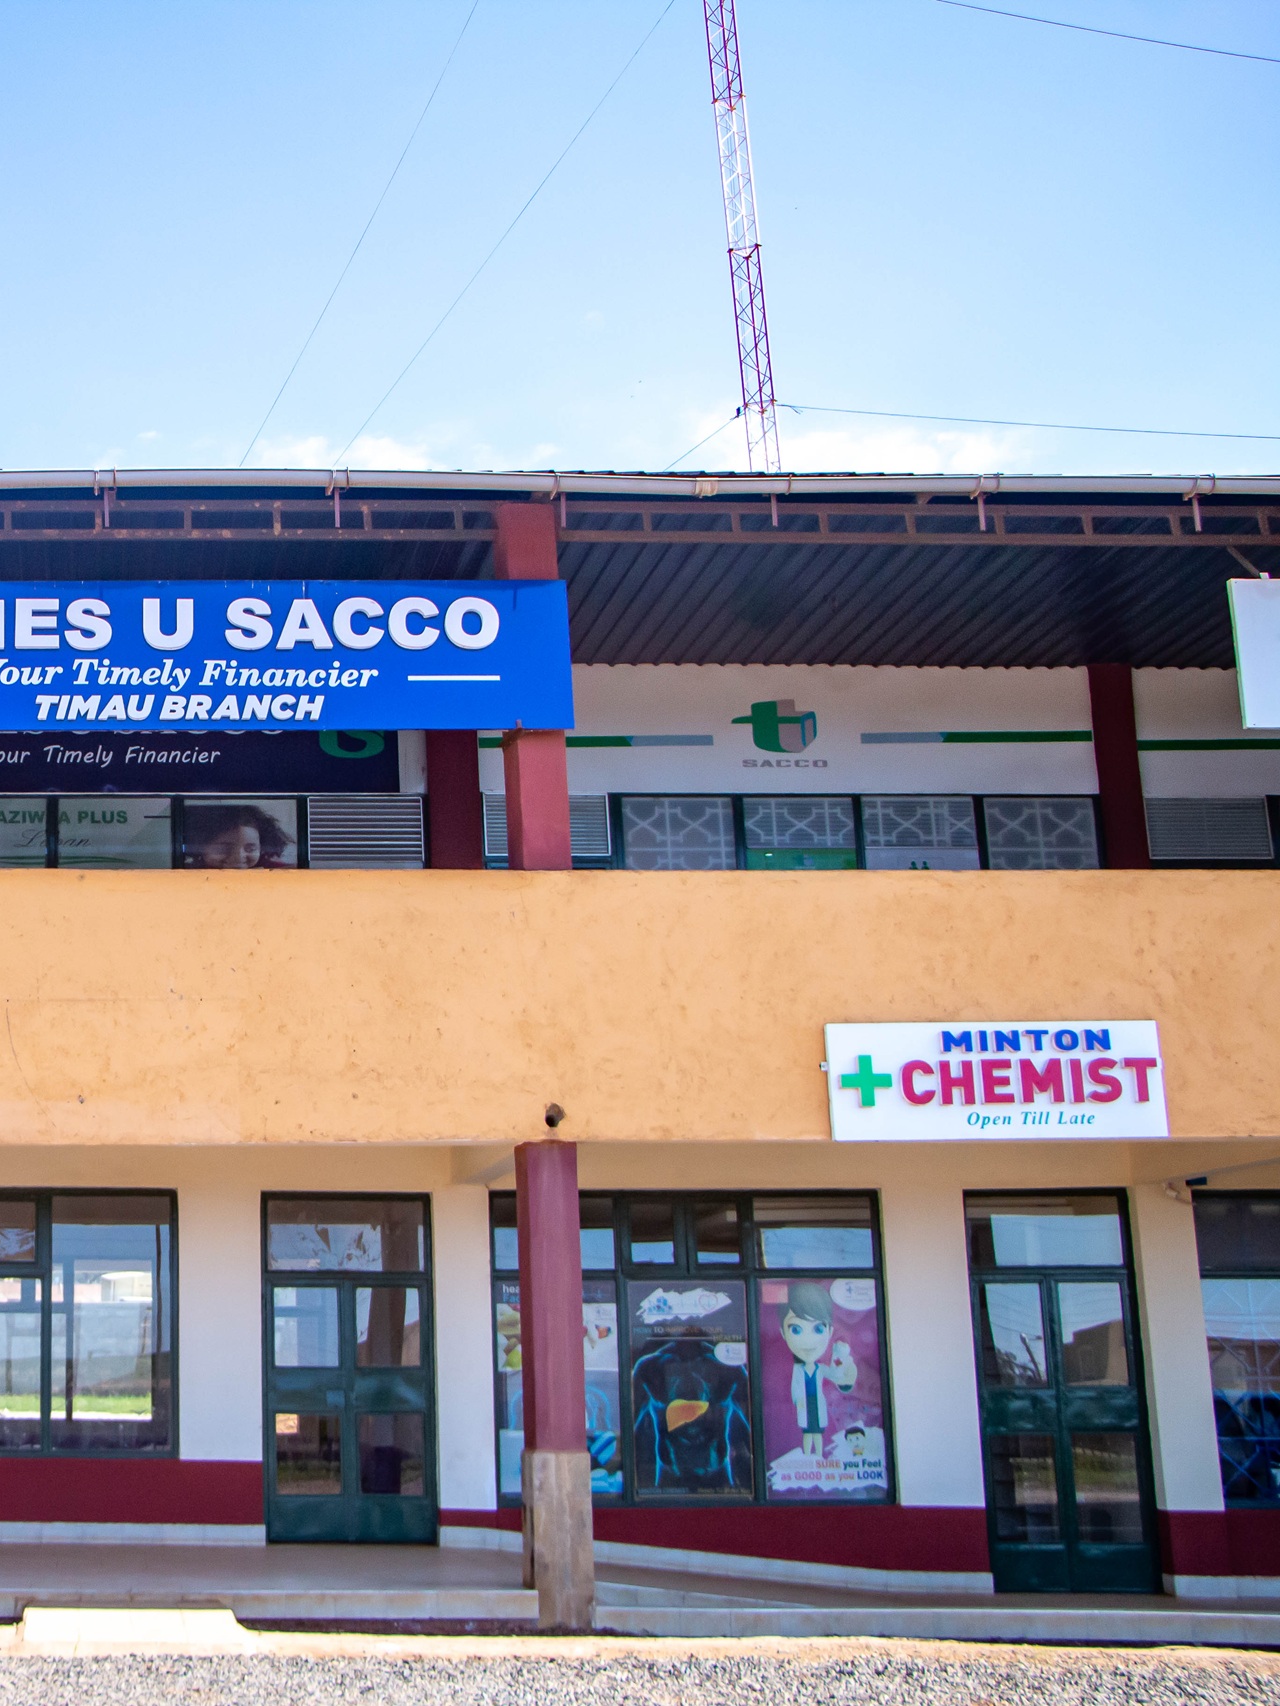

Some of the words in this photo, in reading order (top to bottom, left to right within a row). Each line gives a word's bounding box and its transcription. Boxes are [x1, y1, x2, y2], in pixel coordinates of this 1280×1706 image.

[142, 598, 194, 650] U
[225, 596, 500, 651] SACCO
[72, 658, 191, 692] Timely
[199, 660, 379, 688] Financier
[34, 694, 155, 721] TIMAU
[159, 694, 325, 721] BRANCH
[43, 744, 114, 768] Timely
[125, 745, 221, 764] Financier
[742, 758, 828, 768] SACCO
[77, 810, 128, 824] PLUS
[940, 1029, 1111, 1053] MINTON
[899, 1057, 1158, 1106] CHEMIST
[967, 1111, 1012, 1129] Open
[1021, 1111, 1050, 1126] Till
[1058, 1111, 1096, 1126] Late
[654, 1326, 664, 1334] TO
[815, 1459, 841, 1469] SURE
[843, 1460, 859, 1471] you
[862, 1458, 882, 1468] Feel
[781, 1473, 791, 1481] as
[794, 1471, 822, 1481] GOOD
[825, 1473, 835, 1481] as
[838, 1473, 854, 1482] you
[857, 1470, 883, 1480] LOOK
